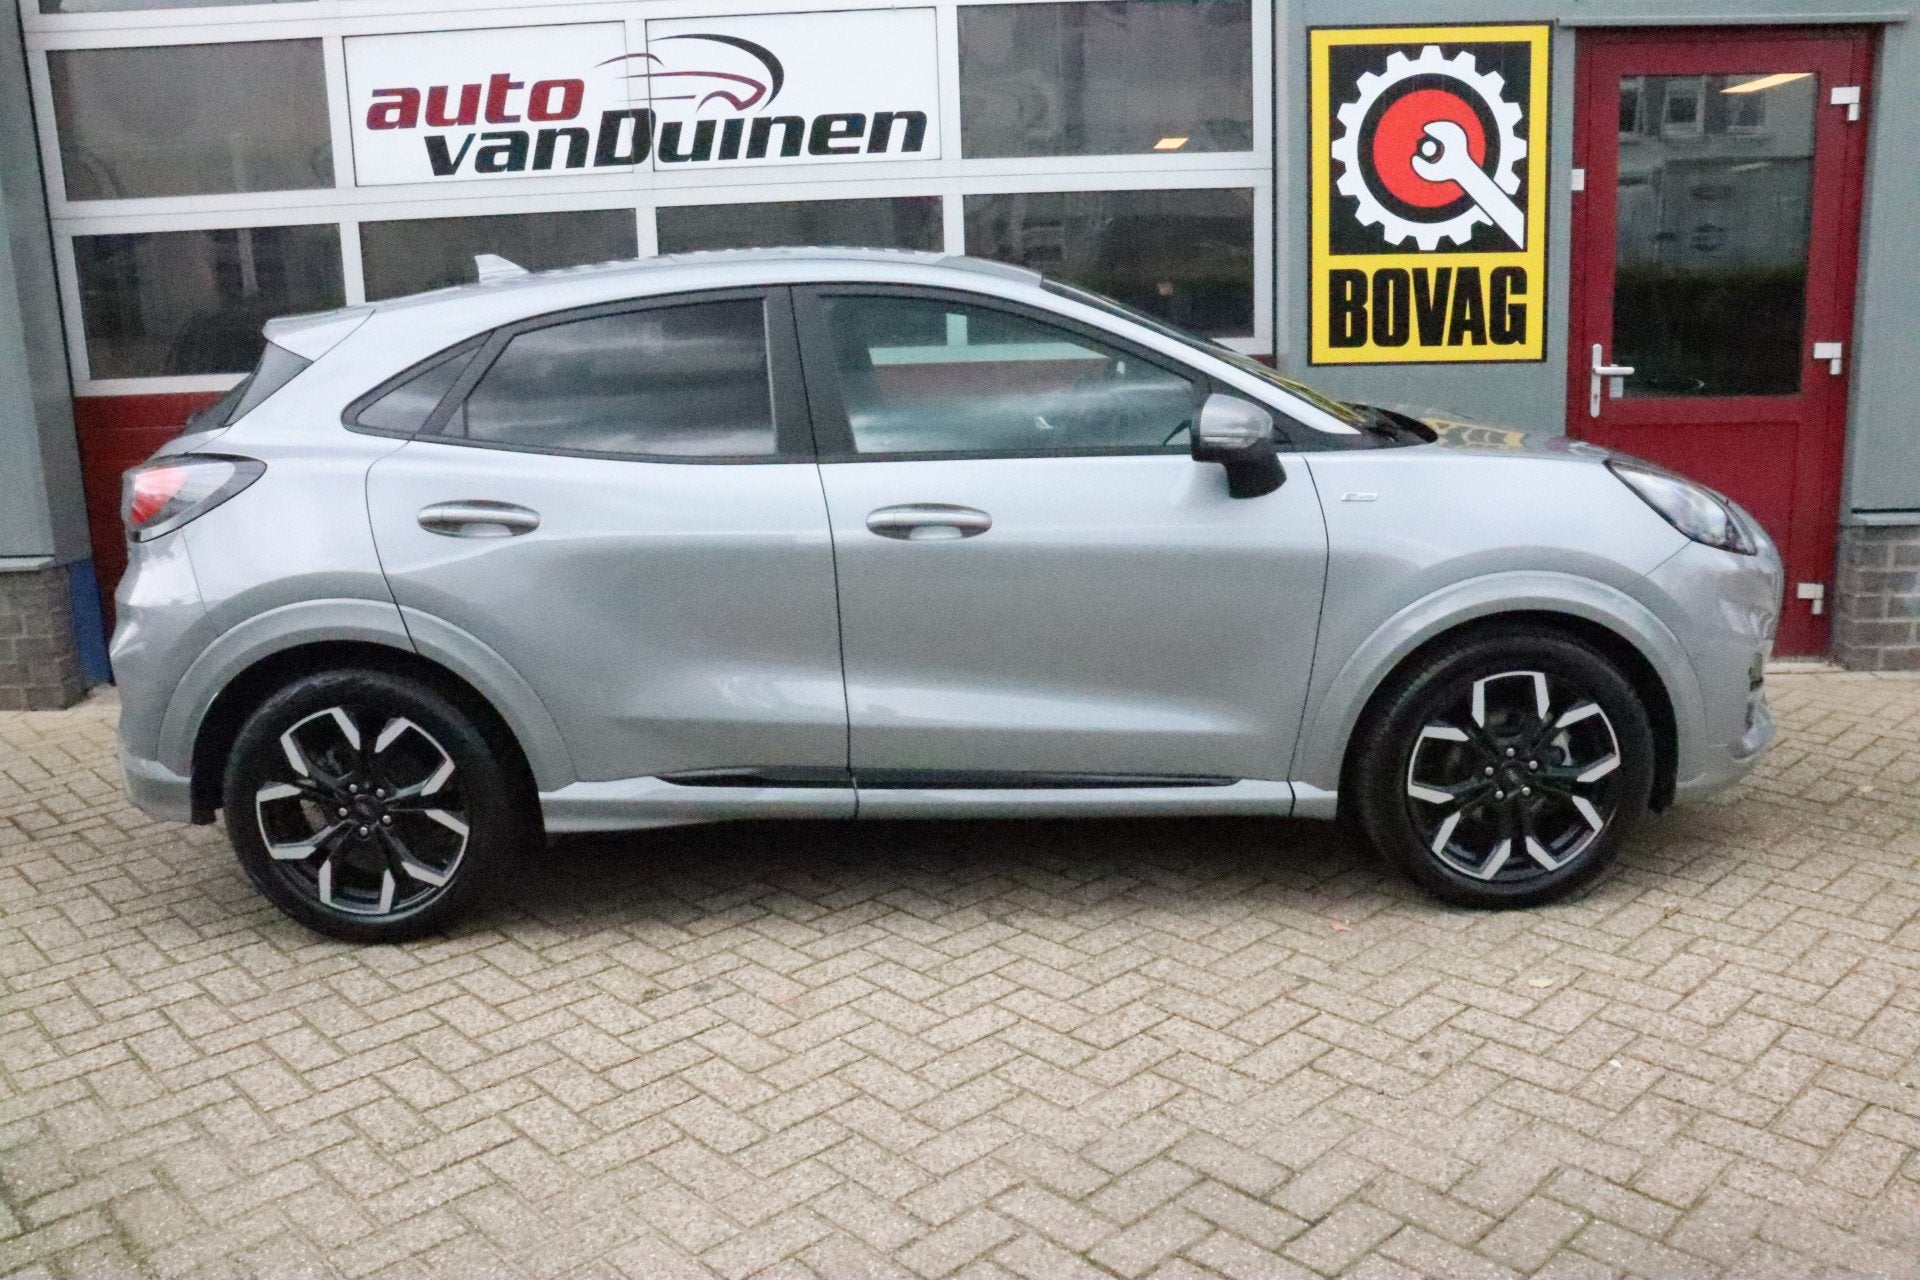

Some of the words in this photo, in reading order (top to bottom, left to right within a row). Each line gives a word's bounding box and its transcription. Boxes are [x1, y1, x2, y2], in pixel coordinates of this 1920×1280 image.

[367, 73, 585, 130] auto
[424, 107, 928, 176] vanDuinen
[1328, 266, 1528, 349] BOVAG
